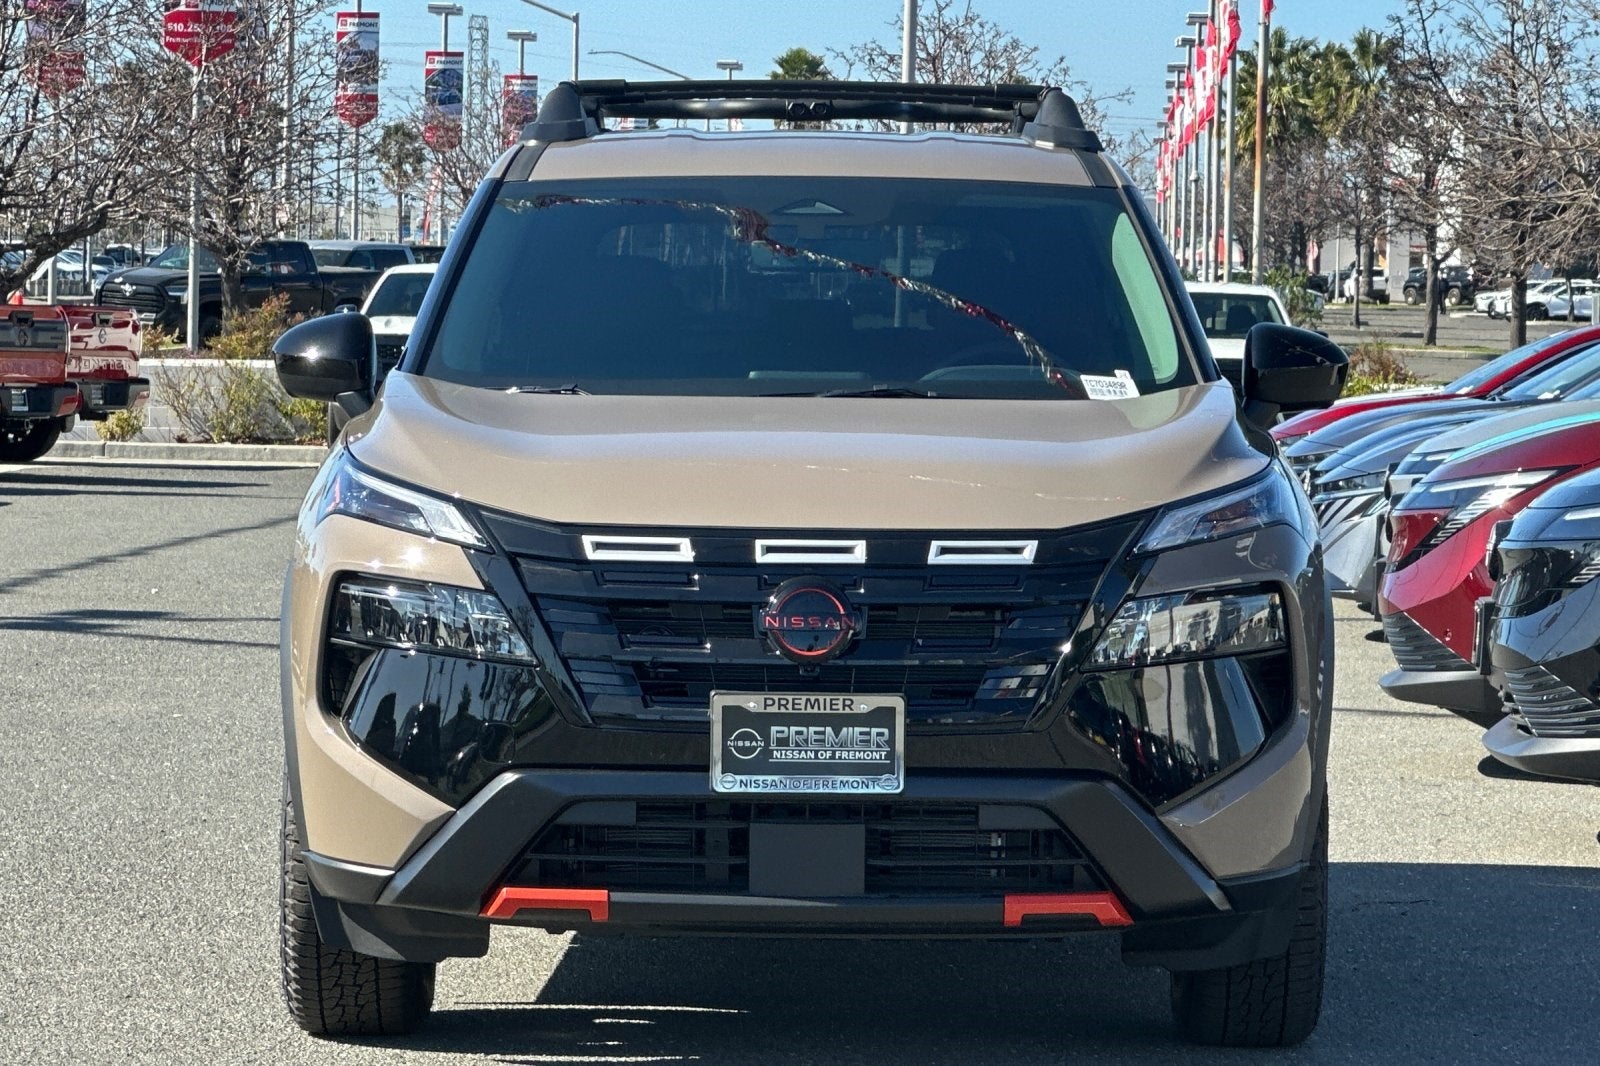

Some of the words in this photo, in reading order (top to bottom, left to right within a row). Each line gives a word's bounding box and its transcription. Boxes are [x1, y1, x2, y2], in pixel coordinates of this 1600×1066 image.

[765, 615, 855, 630] NISSAN
[763, 697, 855, 711] PREMIER
[770, 726, 890, 749] PREMIER
[773, 750, 816, 760] NISSAN
[818, 750, 833, 760] OF
[836, 750, 887, 760] FREMONT
[739, 779, 789, 789] NISSAN
[791, 780, 810, 789] OF
[813, 779, 877, 790] FREMONT
